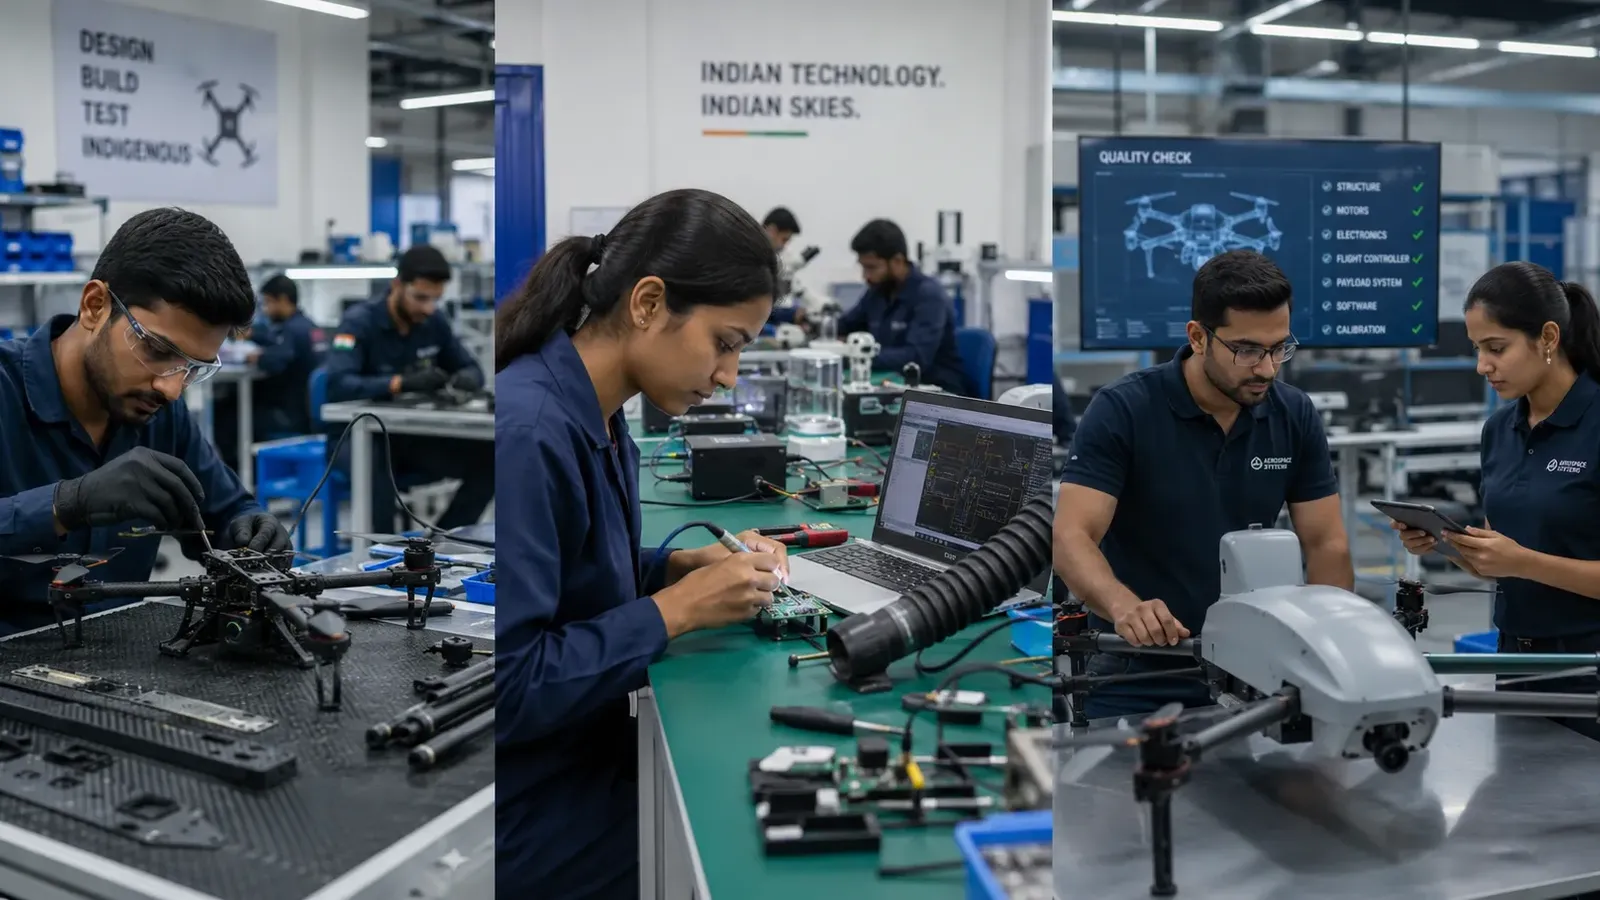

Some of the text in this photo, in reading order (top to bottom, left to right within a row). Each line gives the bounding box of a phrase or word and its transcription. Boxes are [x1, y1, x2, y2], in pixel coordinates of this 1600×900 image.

[80, 29, 155, 63] DESIGN
[81, 64, 140, 93] BUILD
[701, 61, 946, 87] INDIAN TECHNOLOGY.
[82, 100, 130, 126] TEST
[701, 94, 861, 119] INDIAN SKIES.
[82, 136, 192, 165] INDIGENOUS
[1099, 150, 1192, 165] QUALITY CHECK
[1336, 182, 1381, 192] STRUCTURE
[1336, 205, 1370, 216] MOTORS
[1336, 230, 1388, 241] ELECTRONICS
[1336, 253, 1411, 264] FLIGHT CONTROLLER
[1336, 277, 1403, 288] PAYLOAD SYSTEM
[1336, 301, 1378, 311] SOFTWARE
[1336, 324, 1386, 335] CALIBRATION
